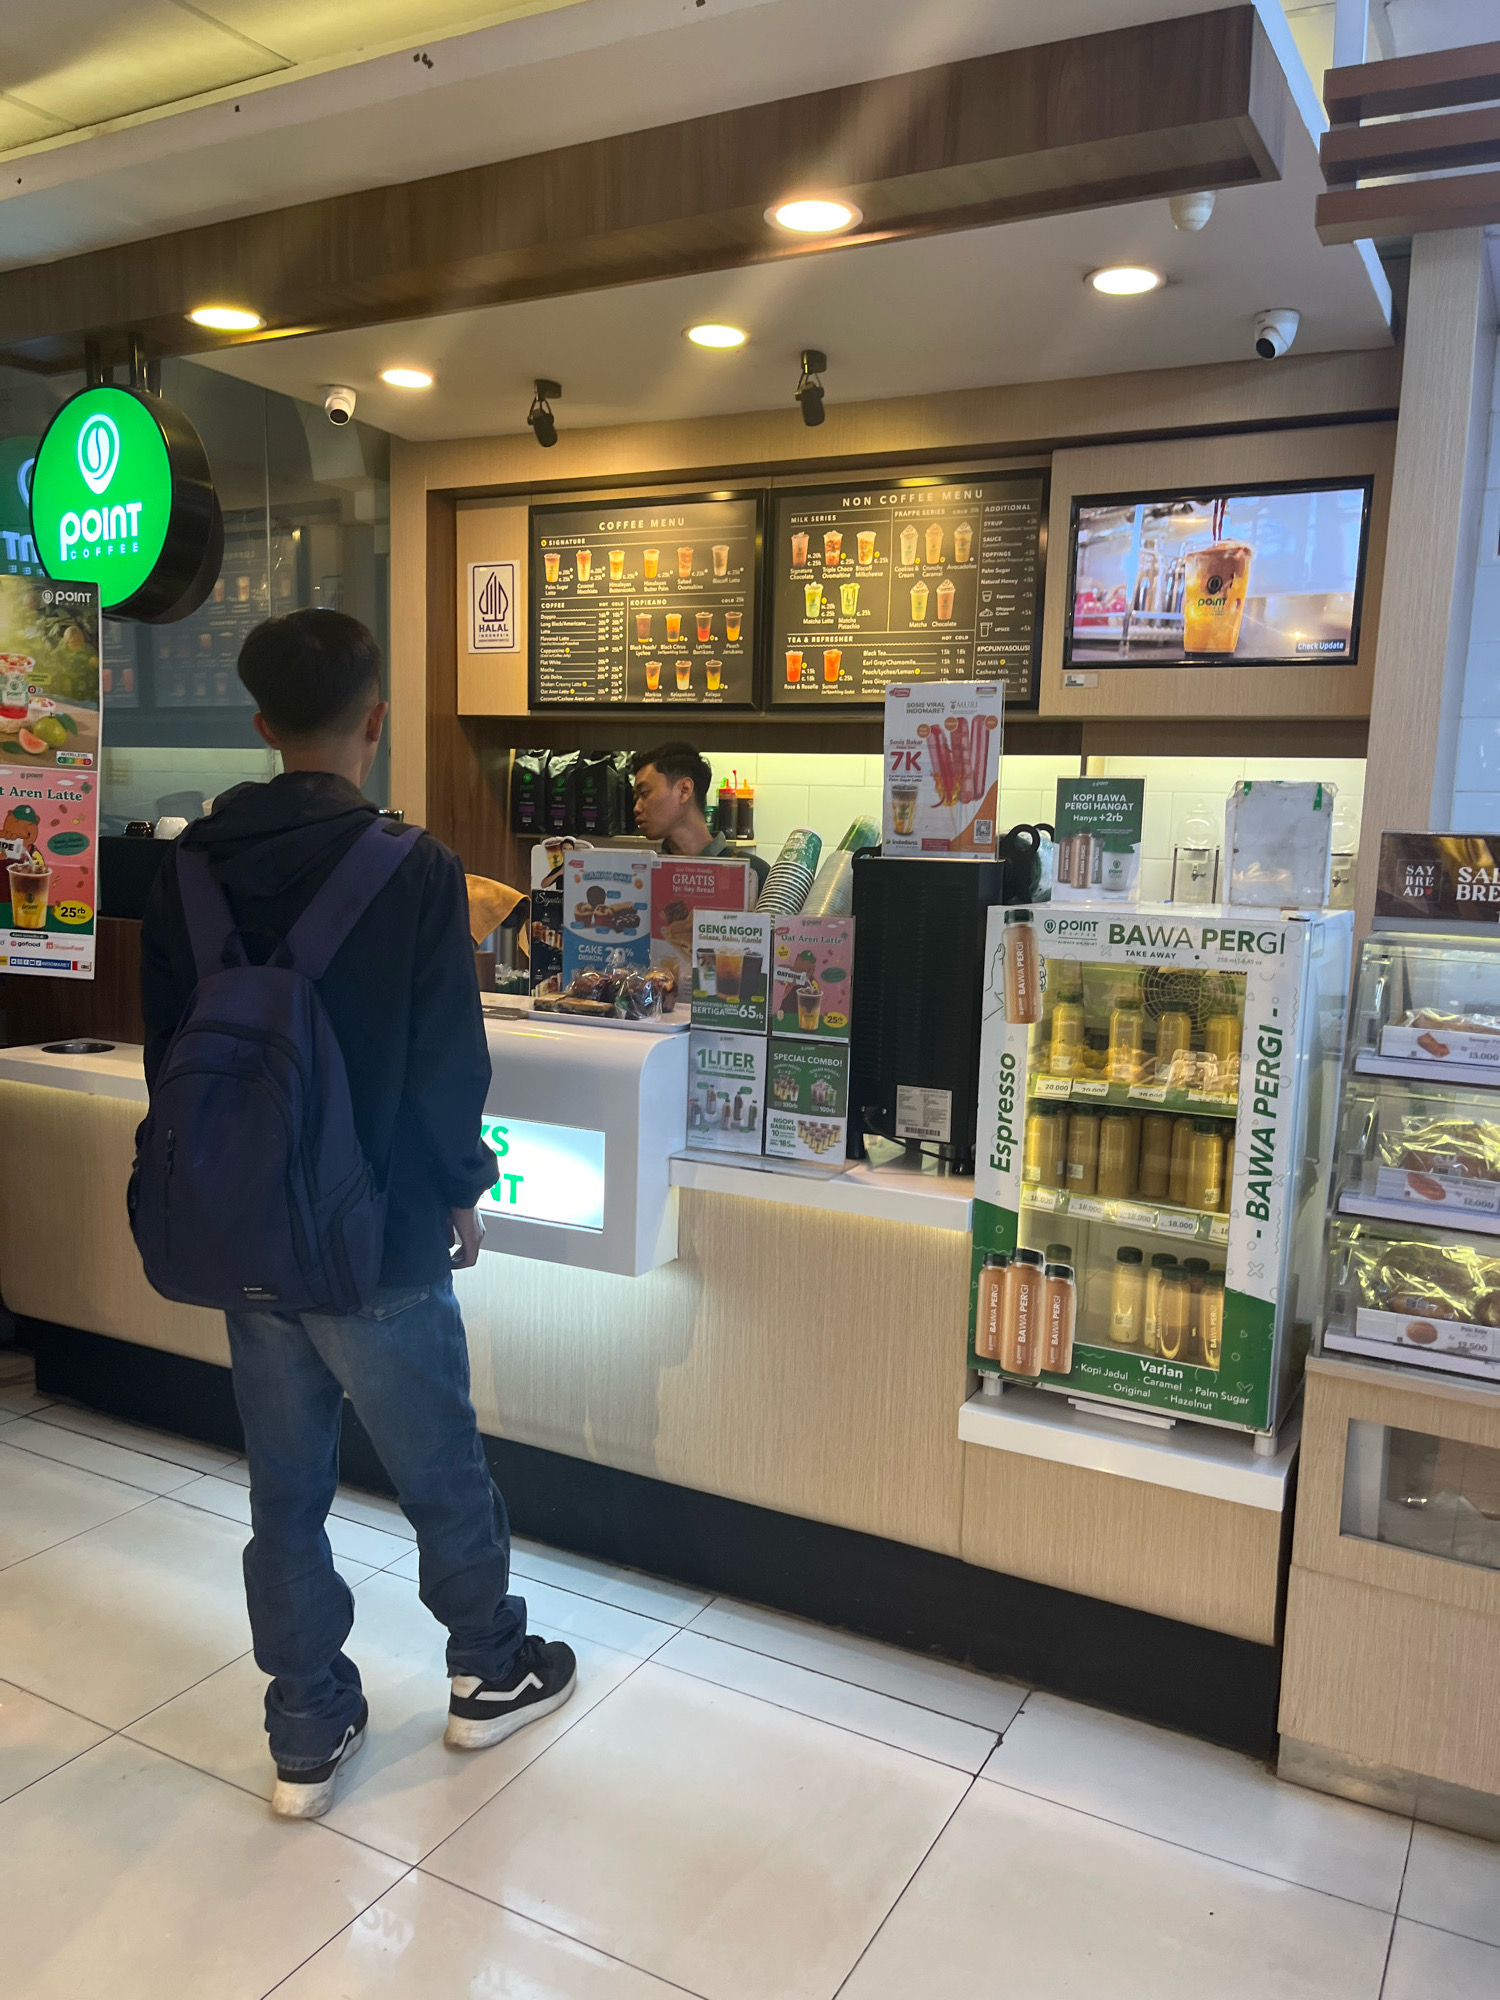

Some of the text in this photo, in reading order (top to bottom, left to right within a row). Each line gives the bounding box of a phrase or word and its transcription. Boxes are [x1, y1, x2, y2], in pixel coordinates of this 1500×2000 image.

[843, 489, 983, 507] NON COFFEE MENU
[894, 508, 945, 517] FRAPPE SERIES
[985, 504, 1031, 513] ADDITIONAL
[811, 514, 837, 522] SERIES
[598, 517, 685, 531] COFFEE MENU
[548, 538, 586, 546] SIGNATURE
[69, 542, 139, 560] COFFEE
[479, 624, 509, 633] HALAL
[1297, 640, 1345, 651] Check Update
[890, 751, 922, 772] 7K
[9, 787, 43, 799] Aren
[47, 789, 83, 801] Latte
[1072, 793, 1127, 803] KOPI BAWA
[1065, 802, 1134, 811] PERGI HANGAT
[1073, 812, 1124, 823] Hanya +2rb
[1406, 865, 1435, 876] SAY
[672, 874, 715, 887] GRATIS
[1405, 876, 1435, 887] BRE
[1402, 886, 1425, 897] AD
[698, 924, 763, 937] GENG NGOPI
[741, 936, 762, 944] Kamis
[781, 934, 842, 944] Oat Aren Latte
[1109, 923, 1286, 955] BAWA PERGI
[578, 944, 603, 955] CAKE
[1125, 950, 1176, 960] TAKE AWAY
[578, 954, 603, 962] DISKON
[1016, 941, 1026, 995] BAWA PERGI
[693, 1007, 725, 1016] BERTIGA
[773, 1053, 843, 1067] SPECIAL COMBO!
[1045, 1084, 1069, 1092] 20.000
[989, 1053, 1019, 1173] Espresso
[773, 1117, 794, 1125] NGOPI
[1245, 1024, 1284, 1222] BAWA PERGI
[770, 1123, 796, 1132] BARENG
[772, 1129, 780, 1137] 10
[1168, 1220, 1194, 1230] 18.000
[991, 1284, 999, 1308] PERGI
[1018, 1284, 1029, 1343] BAWA PERGI
[1051, 1295, 1061, 1345] BAWA PERGI
[1081, 1363, 1129, 1381] Kopi Jadul
[1140, 1360, 1184, 1379] Varian
[1143, 1376, 1183, 1392] Caramel
[1113, 1383, 1151, 1398] Original
[1195, 1386, 1250, 1406] Palm Sugar
[1170, 1394, 1213, 1411] Hazelnut
